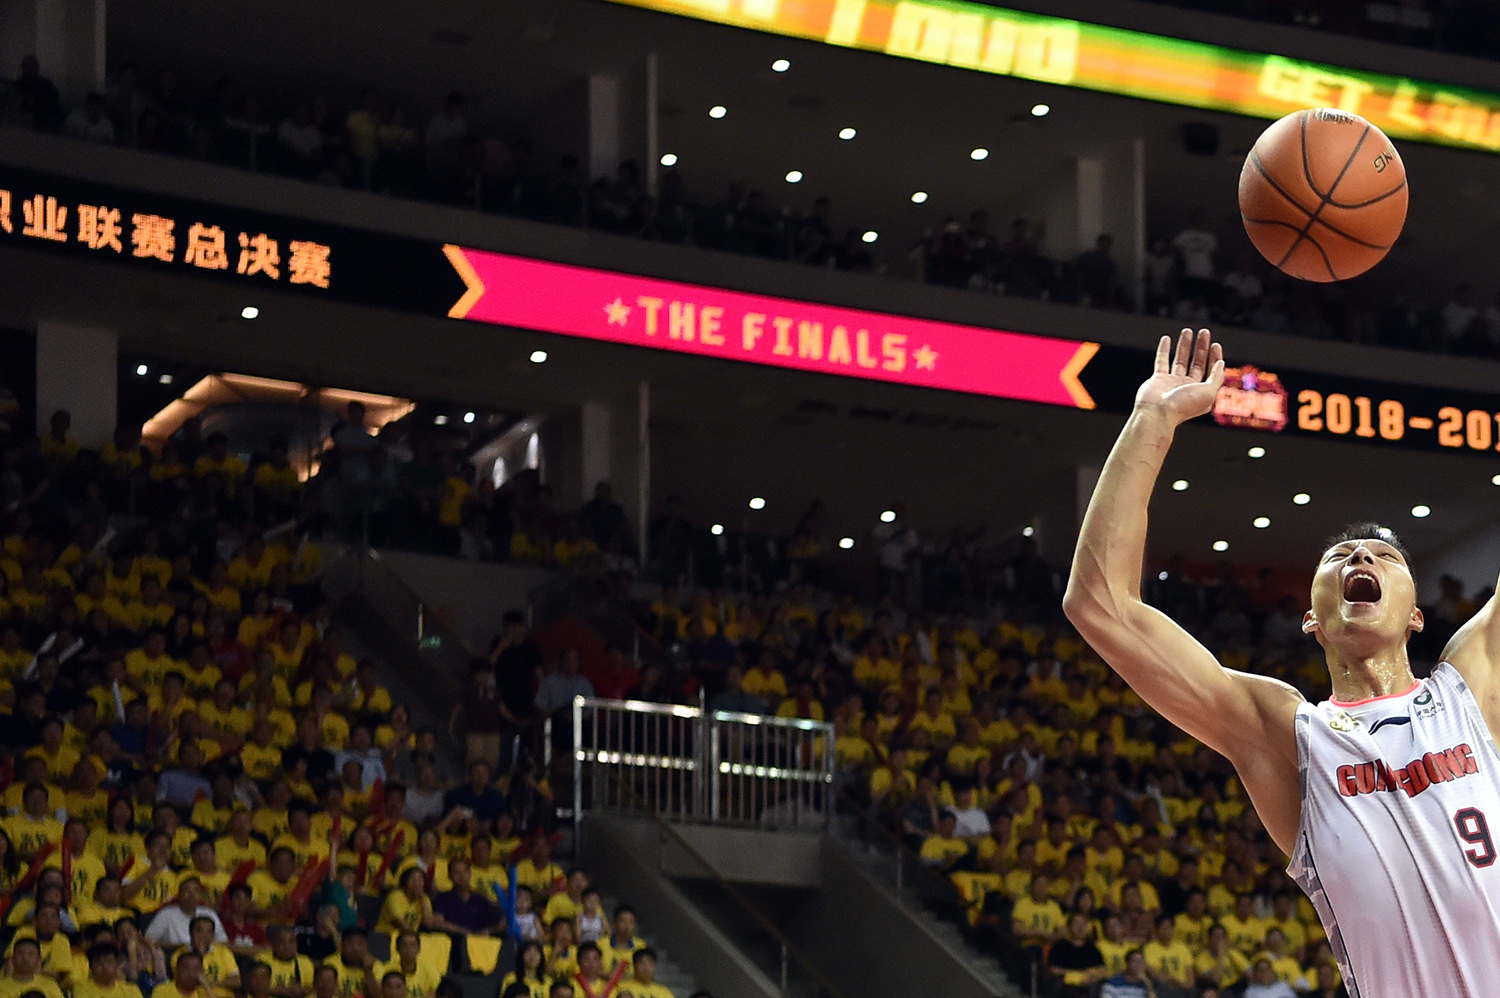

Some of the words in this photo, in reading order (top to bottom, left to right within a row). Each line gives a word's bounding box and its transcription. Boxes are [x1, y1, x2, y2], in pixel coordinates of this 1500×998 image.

[636, 295, 726, 347] THE
[742, 312, 909, 373] FINALS
[1453, 806, 1498, 869] 9
